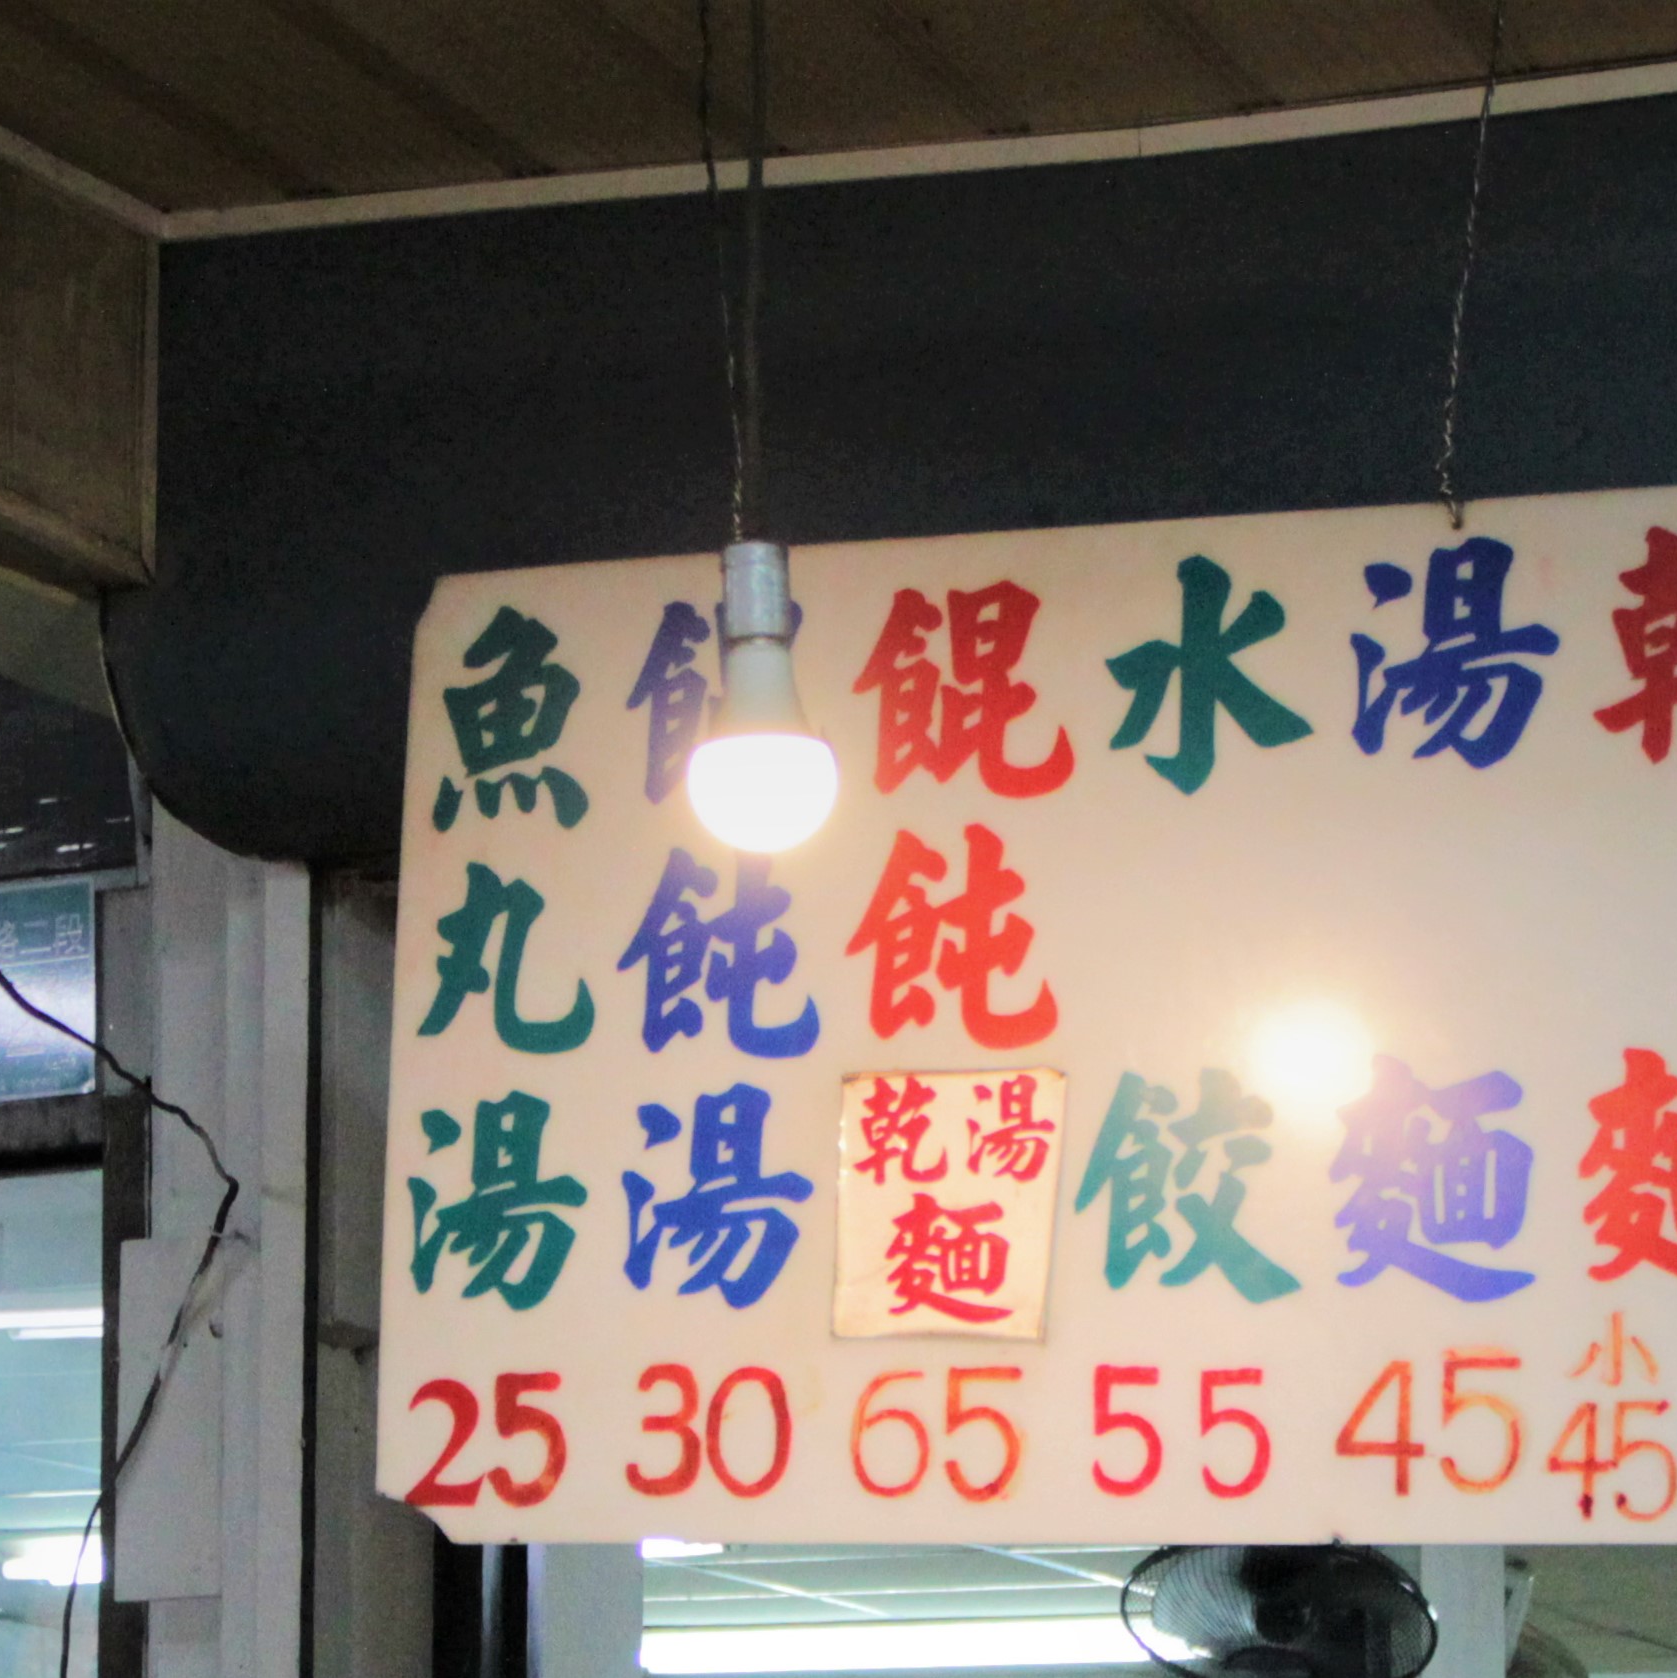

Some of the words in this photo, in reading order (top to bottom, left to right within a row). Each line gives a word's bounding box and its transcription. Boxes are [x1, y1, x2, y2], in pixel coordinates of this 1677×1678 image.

[844, 579, 1074, 1050] 餛飩
[406, 604, 595, 1312] 魚丸湯
[1074, 555, 1314, 1307] 水餃
[1327, 537, 1560, 1305] 湯麵
[1580, 1312, 1659, 1387] 小
[404, 1370, 565, 1509] 25
[625, 1362, 793, 1498] 30
[850, 1366, 1023, 1503] 65
[1090, 1365, 1272, 1499] 55
[1334, 1350, 1523, 1498] 45
[1546, 1398, 1677, 1522] 45
